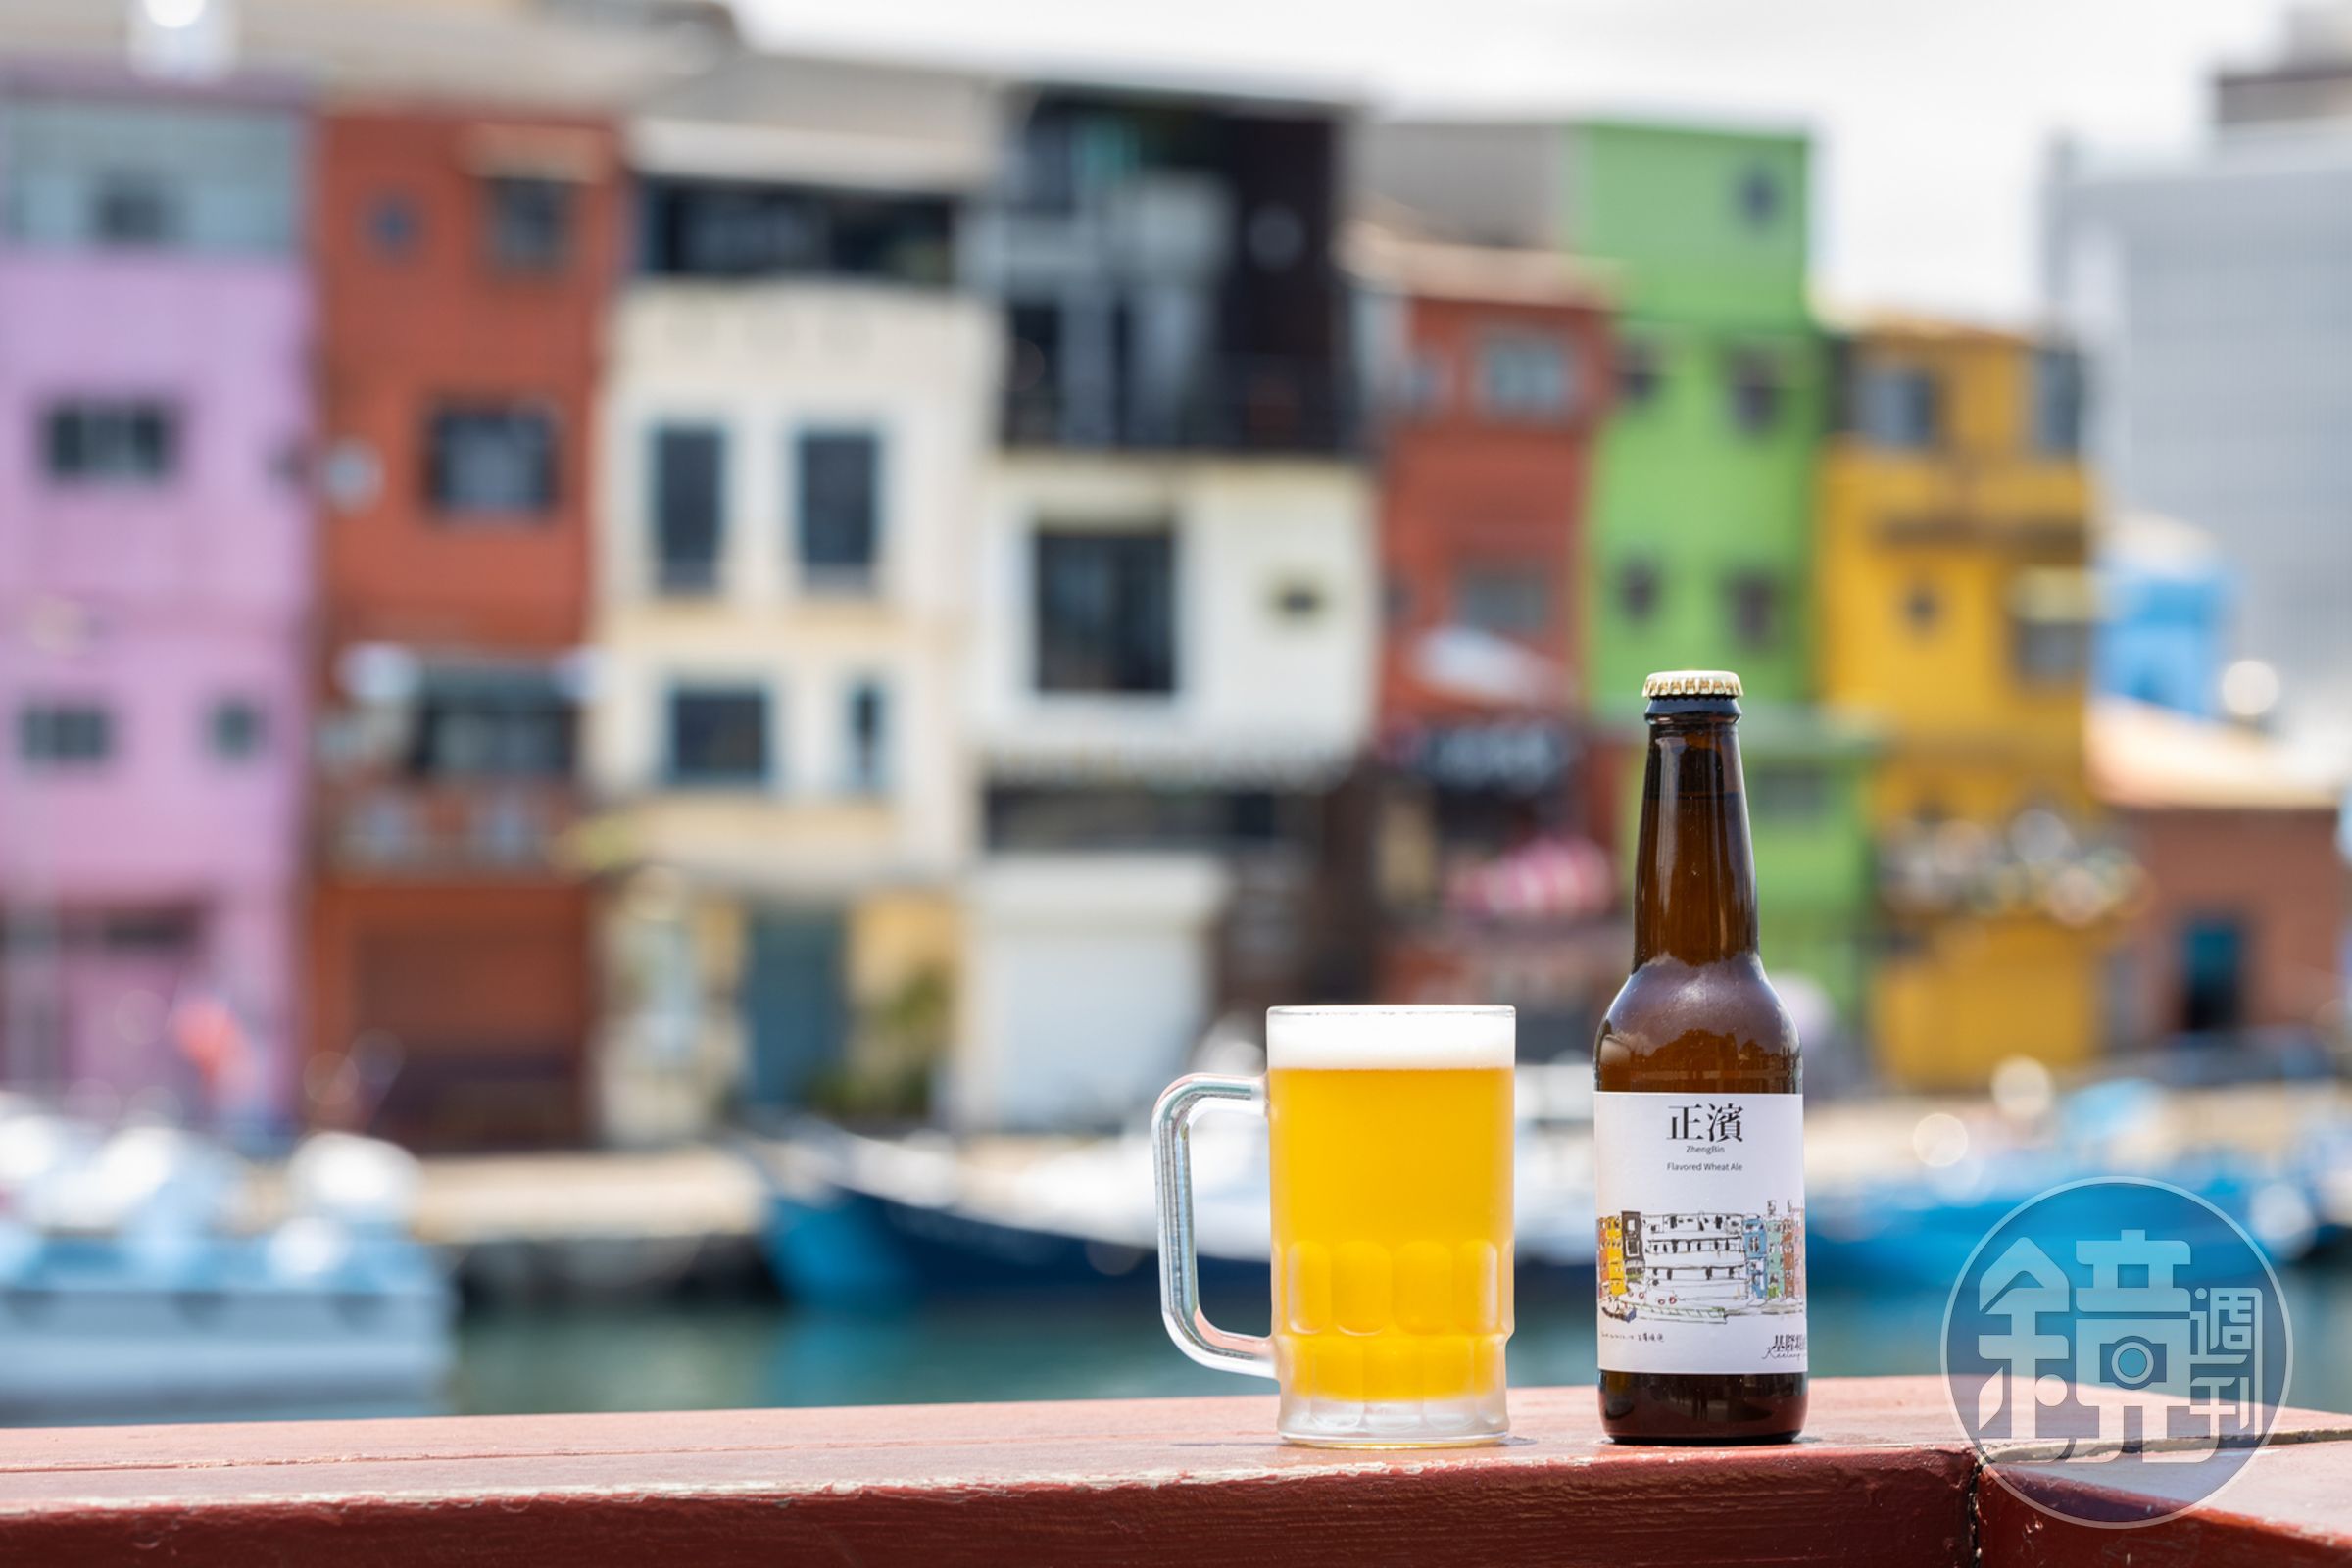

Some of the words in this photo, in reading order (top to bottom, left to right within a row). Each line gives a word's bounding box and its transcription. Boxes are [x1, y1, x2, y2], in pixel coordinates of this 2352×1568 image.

[1666, 1103, 1743, 1143] 正濱
[1686, 1145, 1725, 1155] ZhengBin
[1667, 1162, 1702, 1171] Flavored
[1703, 1162, 1729, 1171] Wheat
[1731, 1162, 1742, 1171] Ale
